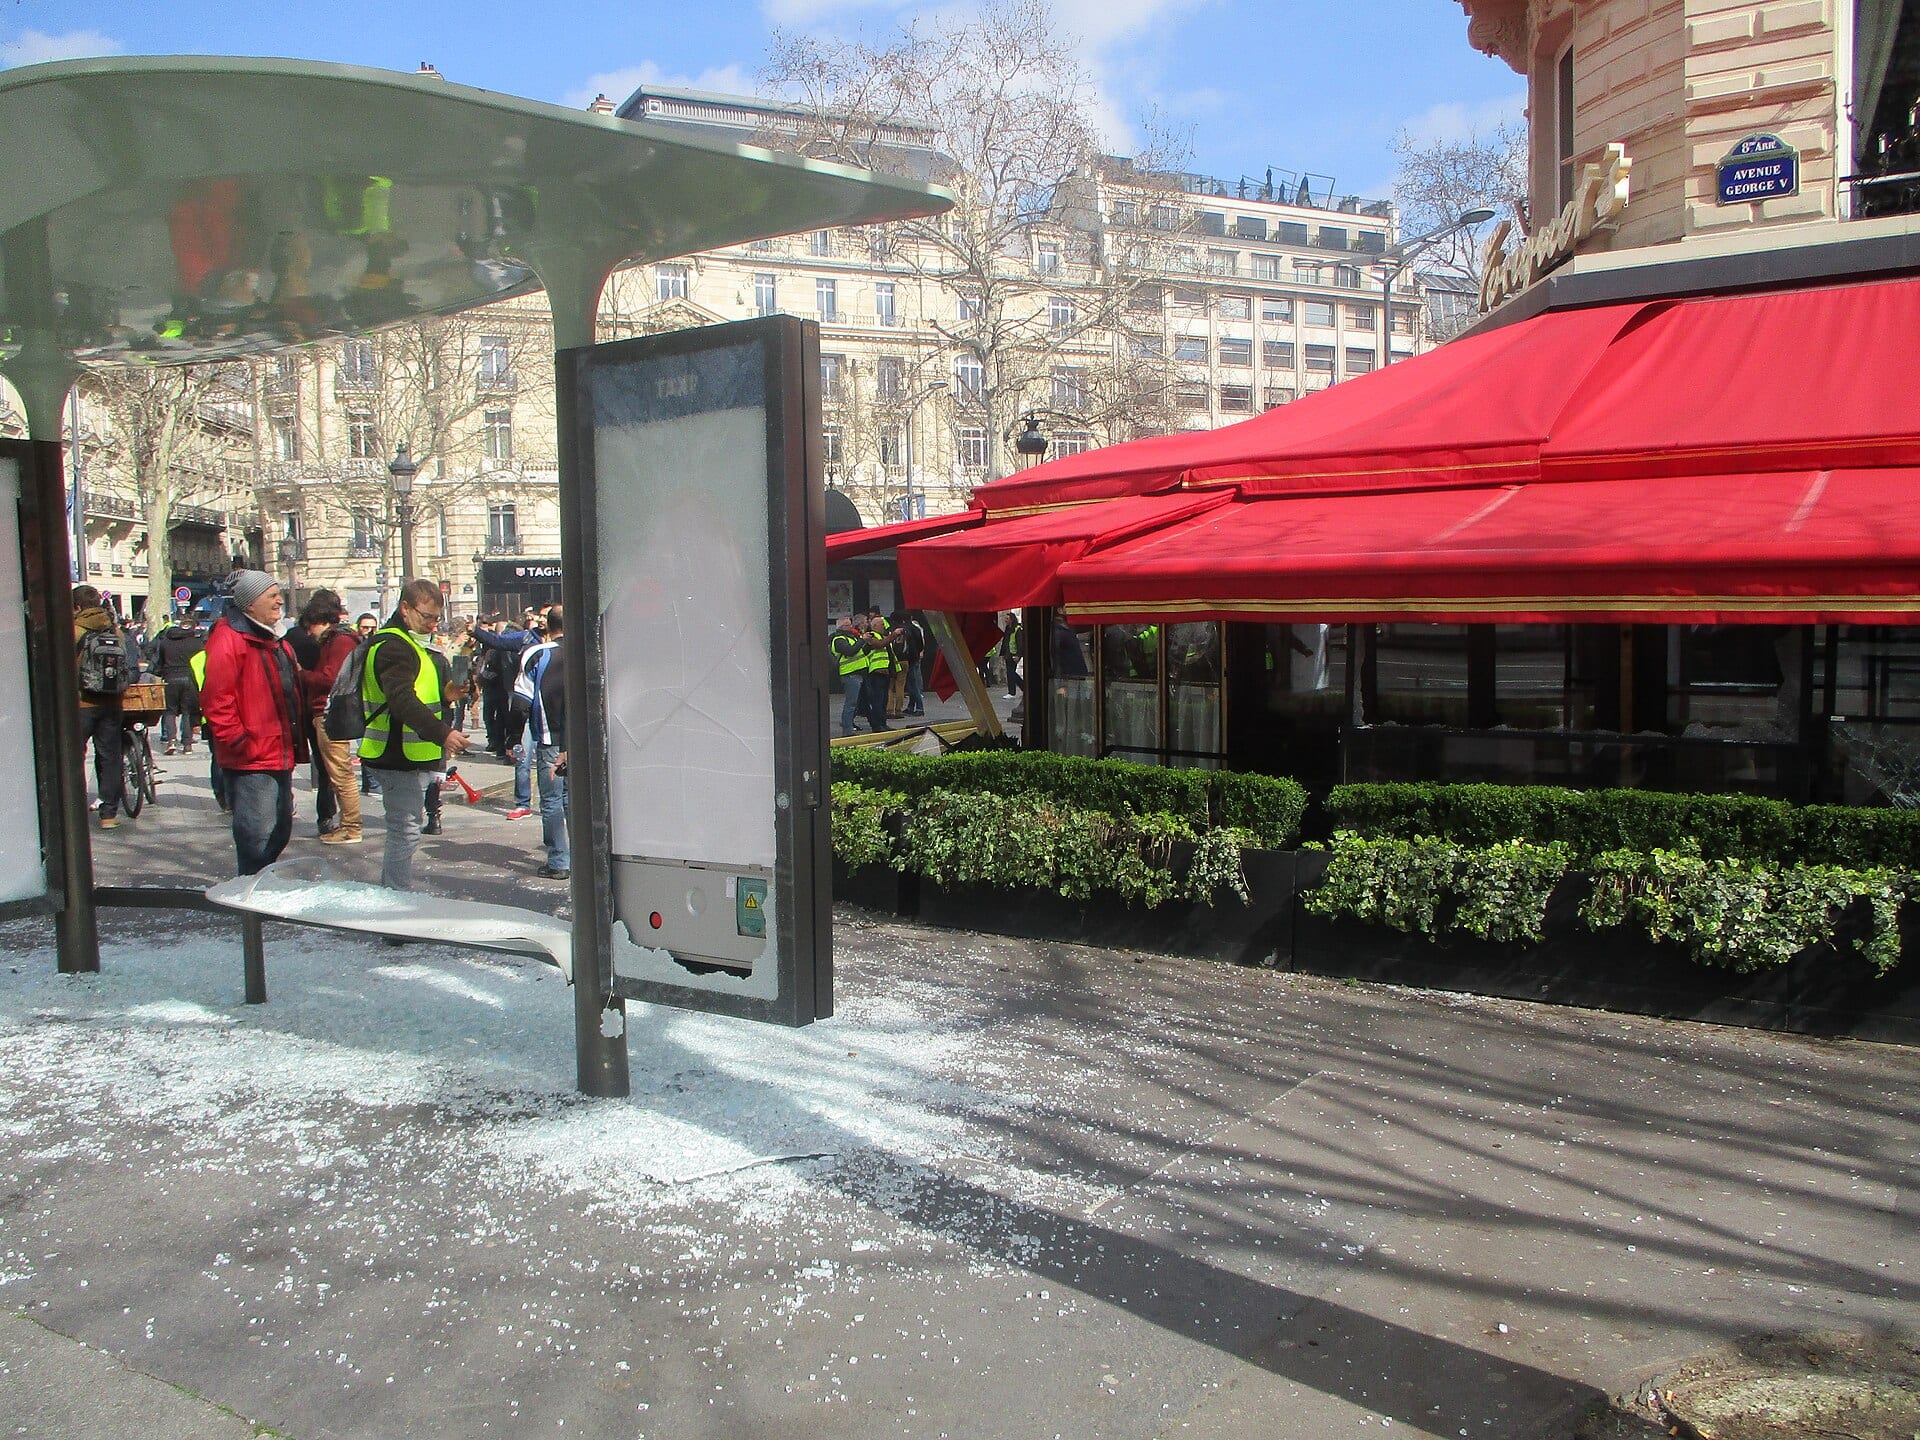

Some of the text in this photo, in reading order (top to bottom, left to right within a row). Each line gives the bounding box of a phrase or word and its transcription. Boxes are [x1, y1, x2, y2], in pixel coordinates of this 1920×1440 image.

[1733, 164, 1781, 180] AVENUE
[1725, 178, 1788, 196] GEORGE V
